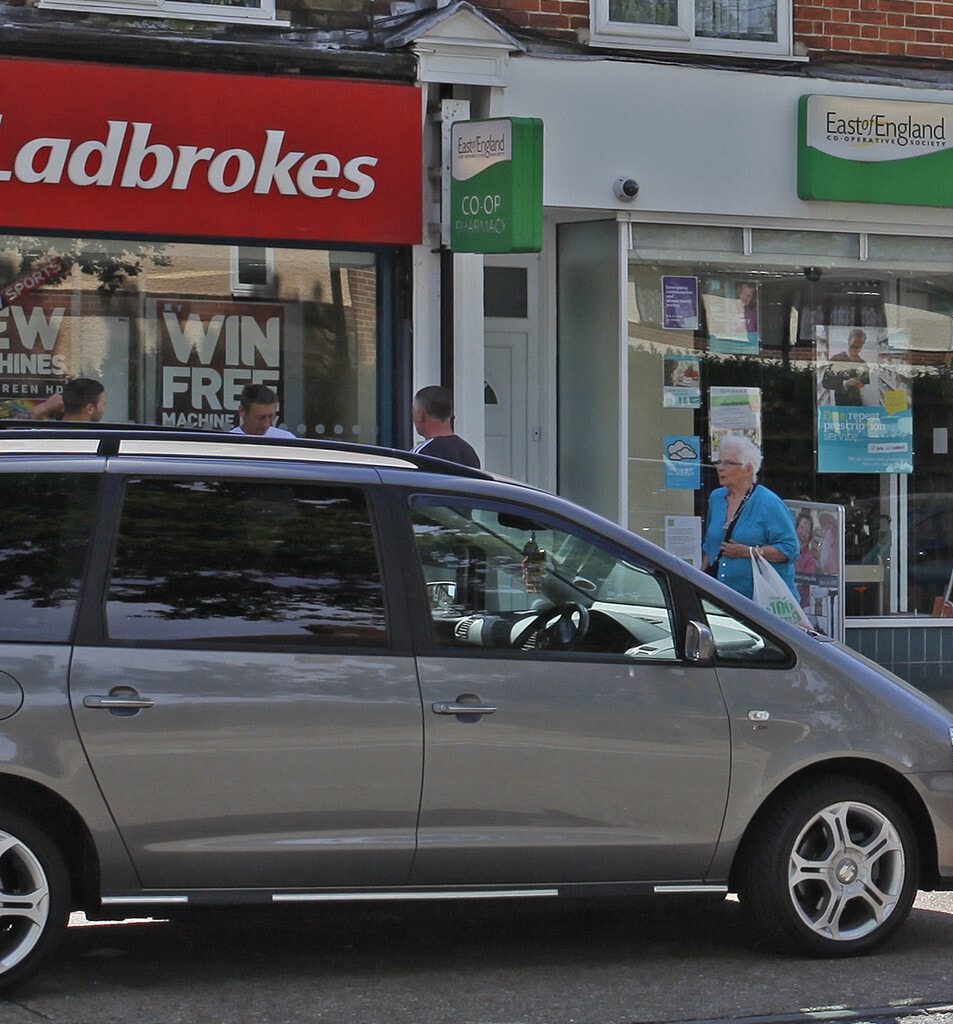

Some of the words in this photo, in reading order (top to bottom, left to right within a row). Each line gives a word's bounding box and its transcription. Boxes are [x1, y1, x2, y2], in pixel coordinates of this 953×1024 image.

[826, 112, 863, 135] East
[875, 114, 946, 146] England
[910, 139, 946, 147] SOCIETY
[461, 194, 502, 215] CO-OP
[5, 259, 63, 302] SPORTS
[162, 312, 280, 368] WIN
[45, 385, 64, 394] HD
[848, 411, 881, 423] repeat
